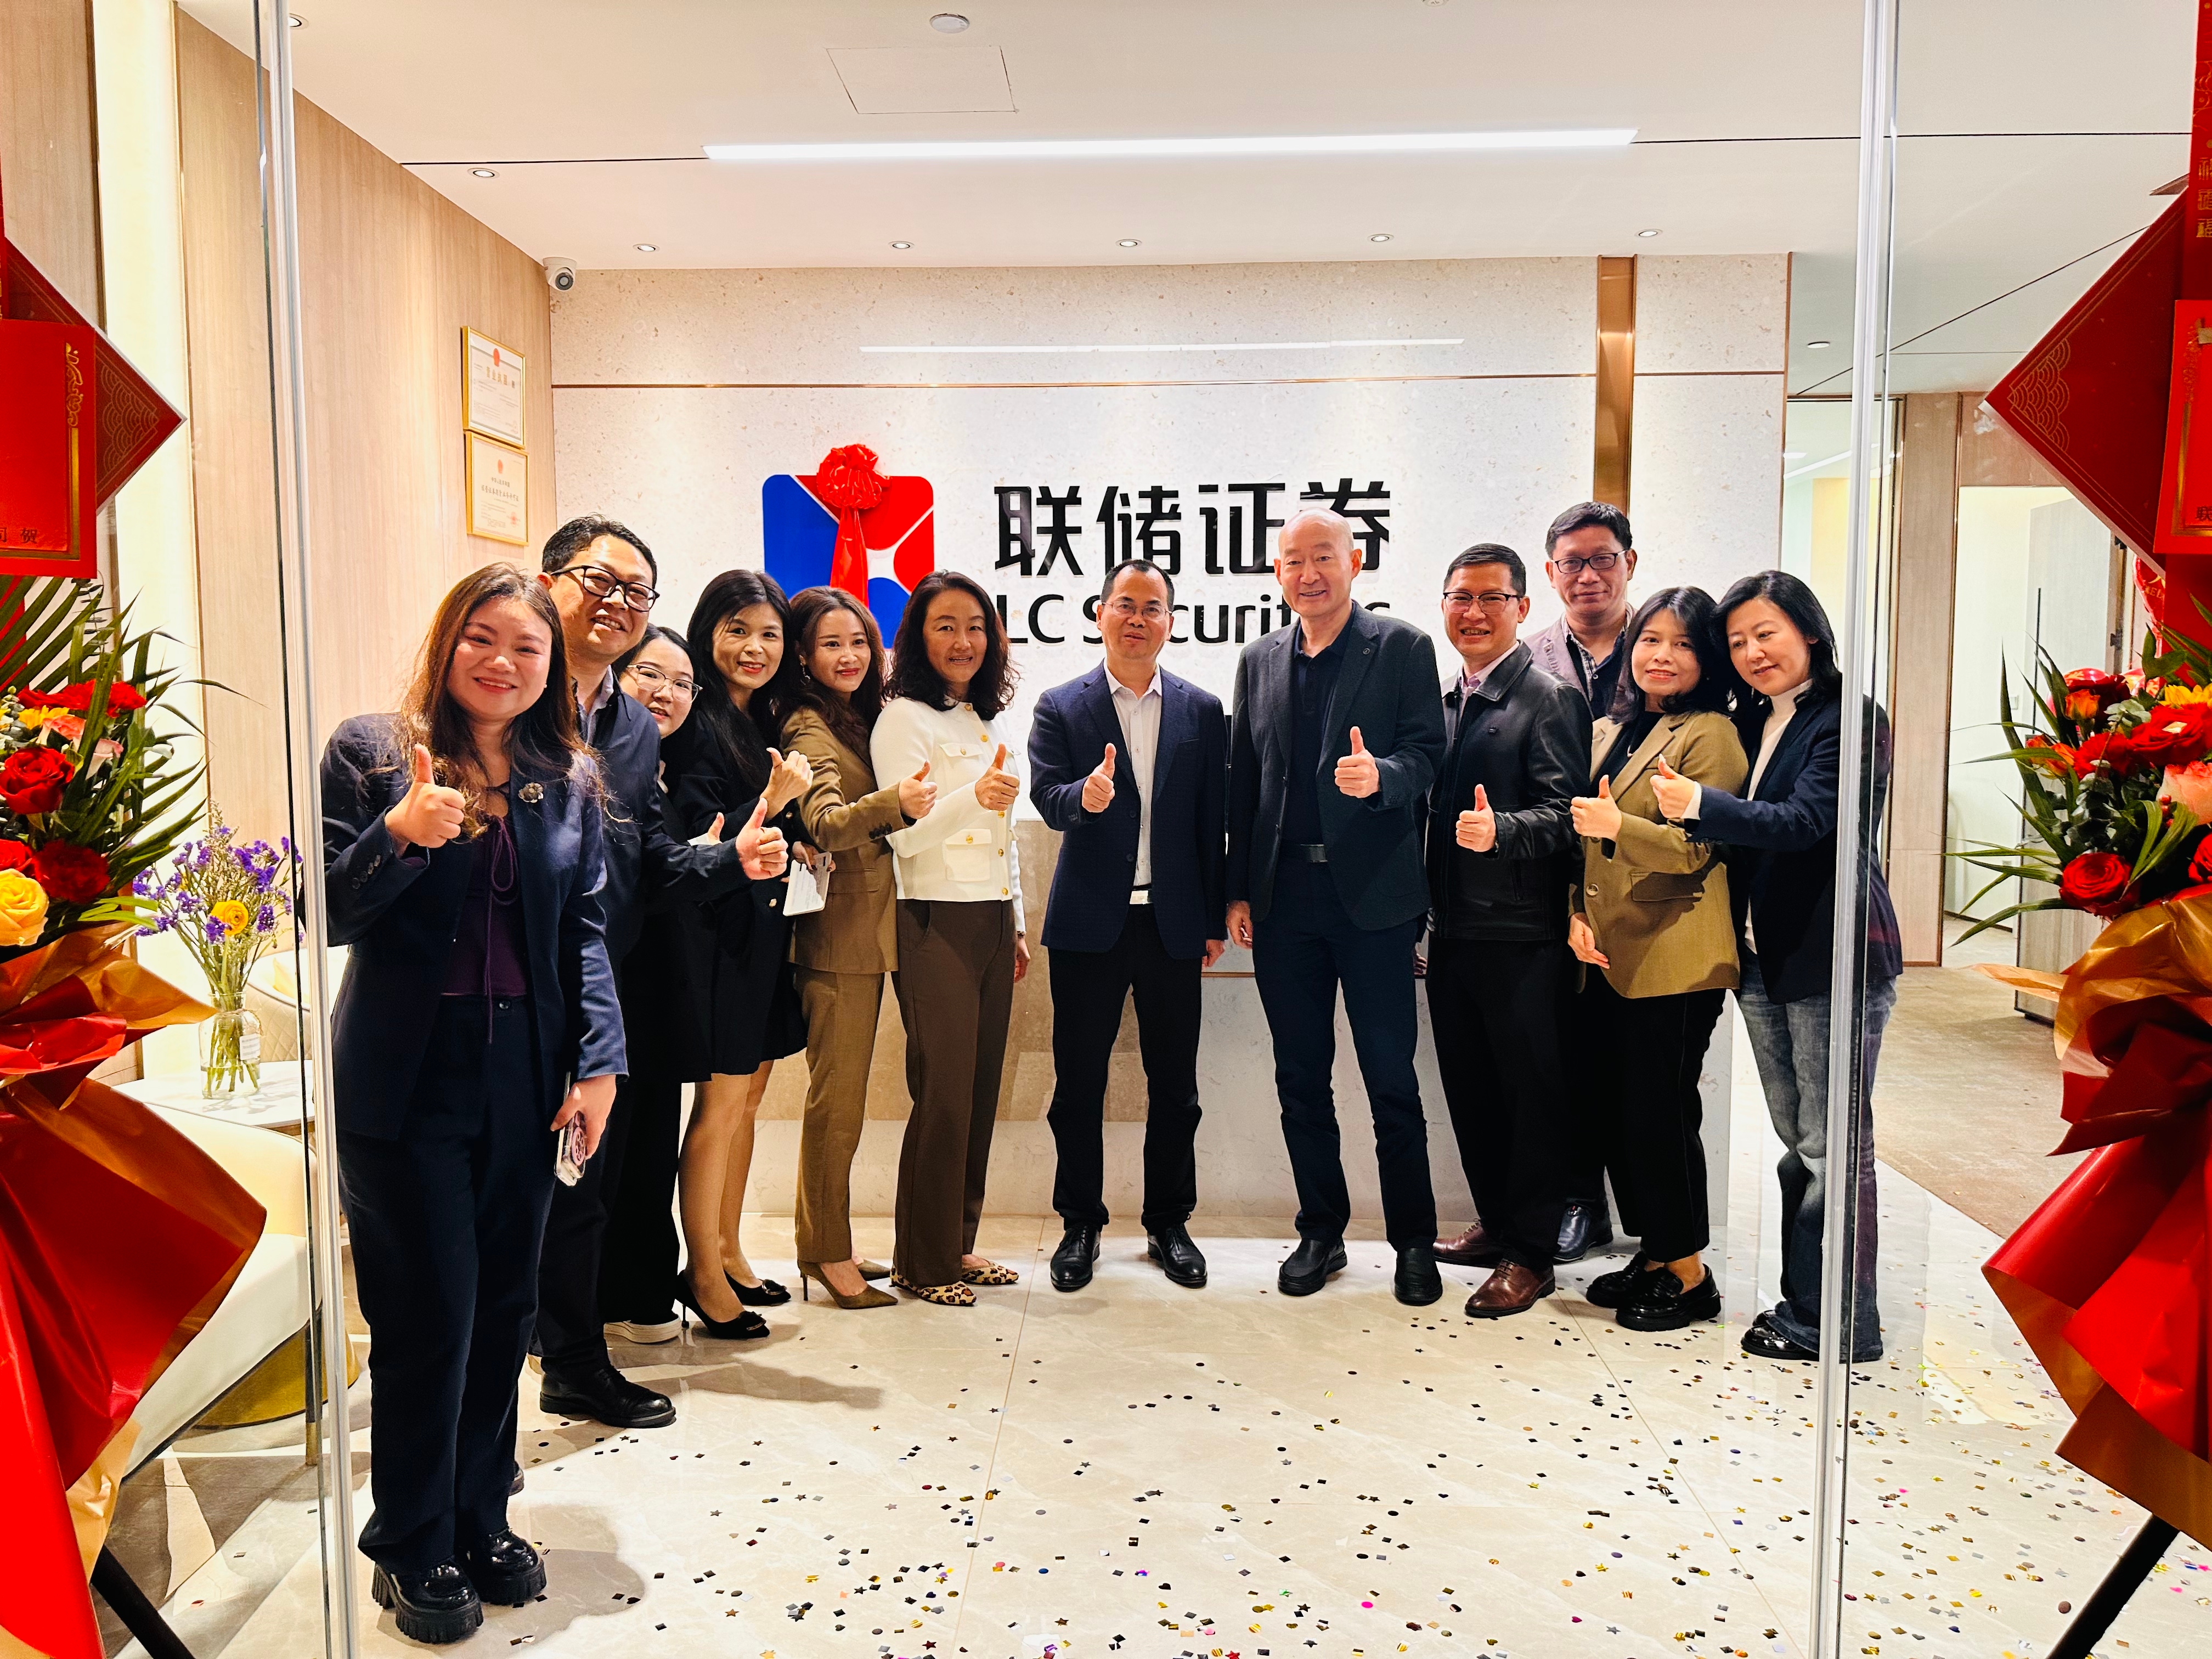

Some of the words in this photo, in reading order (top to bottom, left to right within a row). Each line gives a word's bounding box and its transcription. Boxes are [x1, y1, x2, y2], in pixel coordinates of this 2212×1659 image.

[994, 478, 1390, 576] 联储证券
[996, 594, 1065, 644] LC
